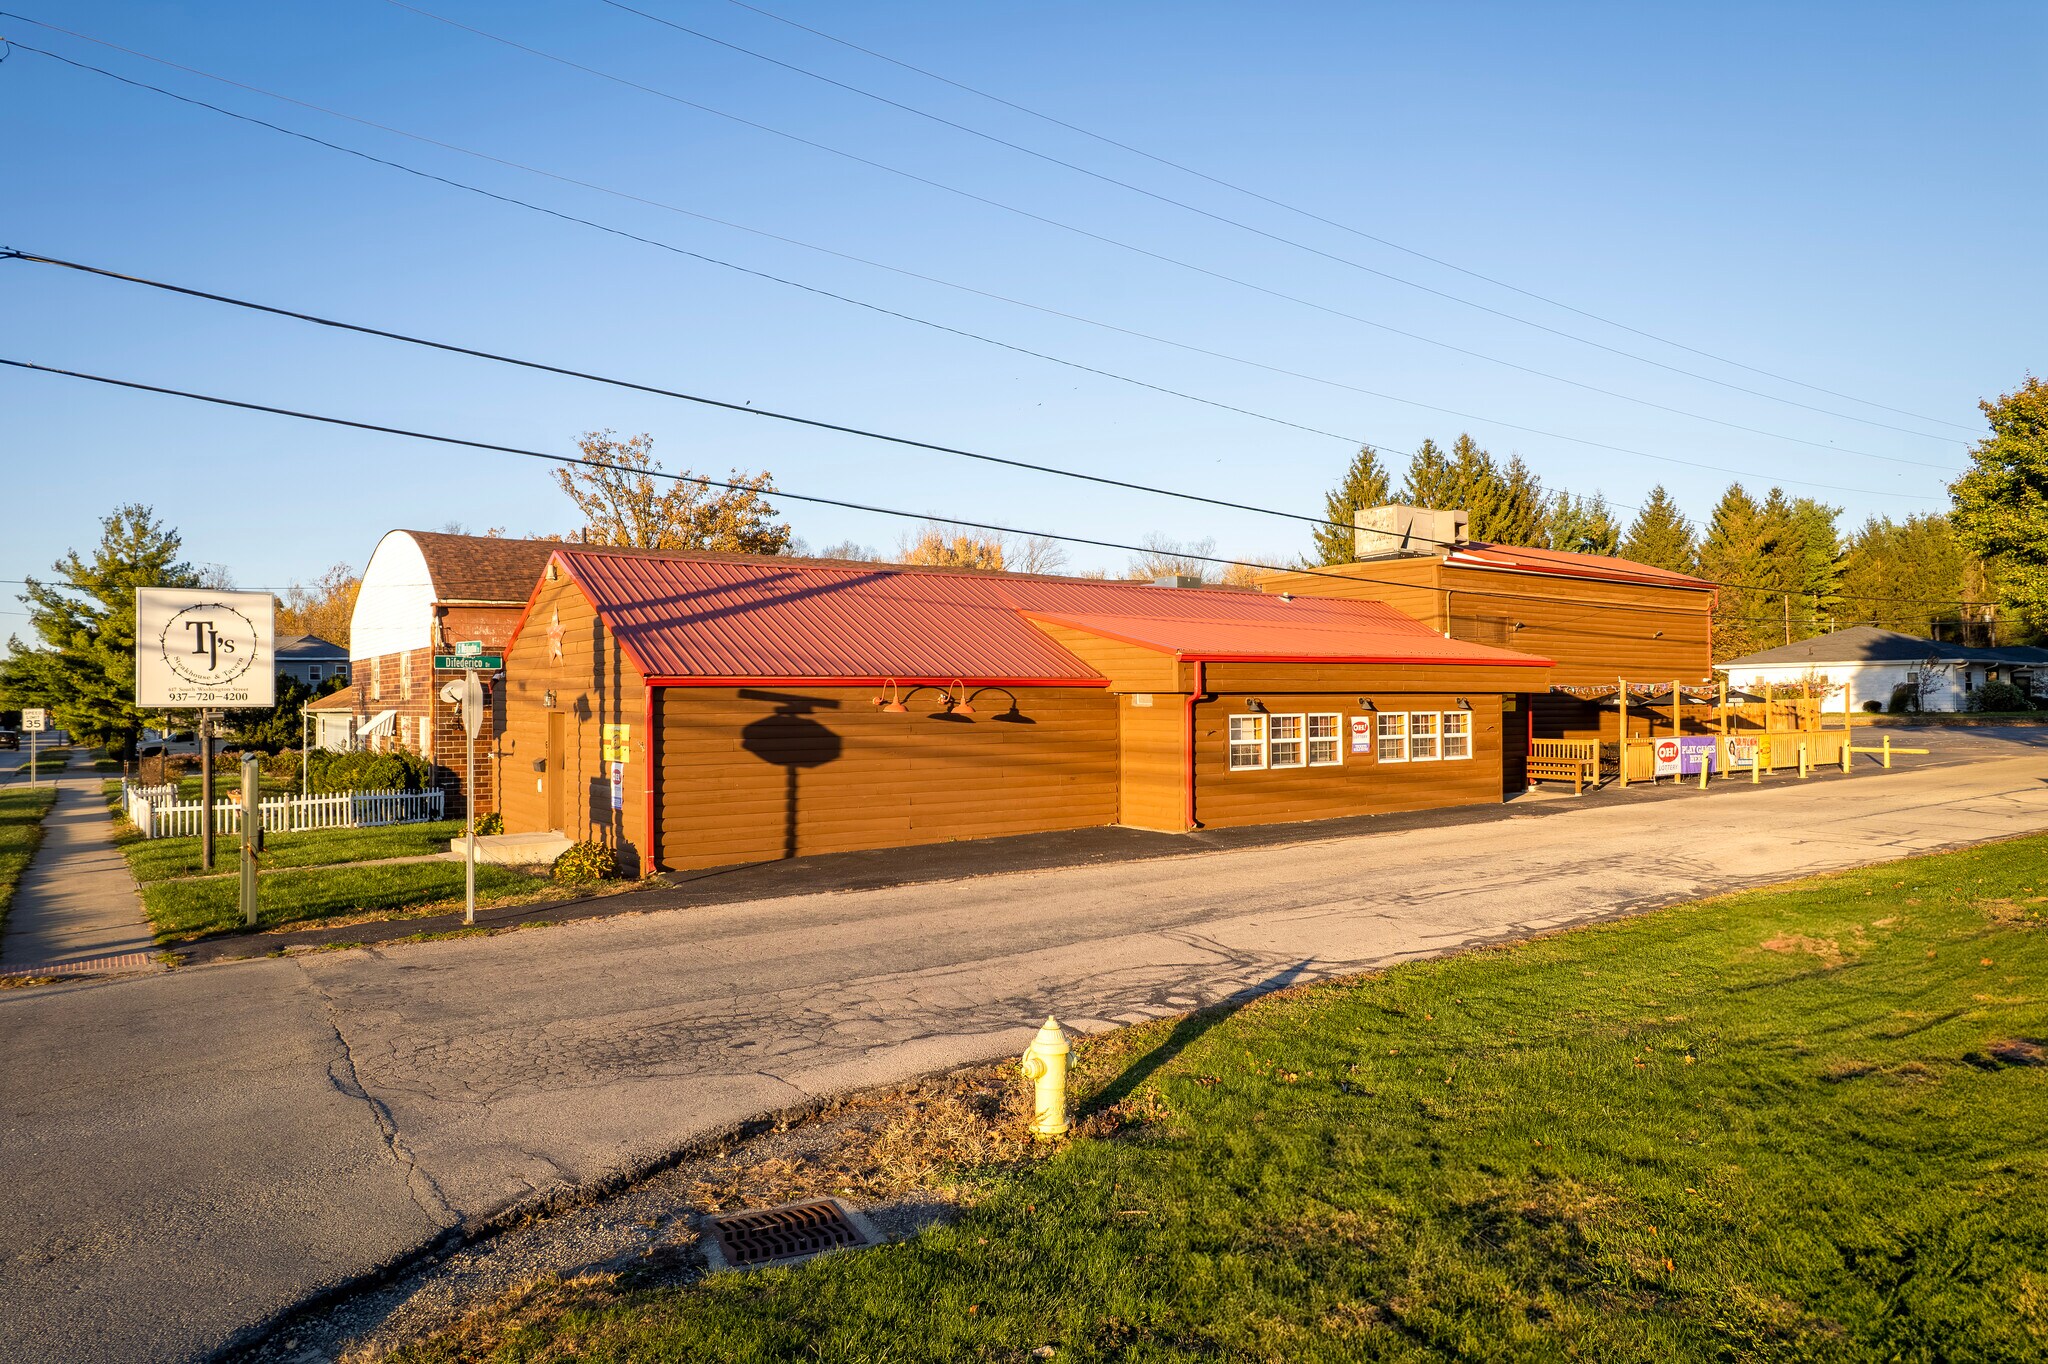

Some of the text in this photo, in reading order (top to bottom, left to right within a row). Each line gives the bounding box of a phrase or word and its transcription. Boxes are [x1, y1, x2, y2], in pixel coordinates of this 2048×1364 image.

[185, 621, 235, 671] TJ's
[174, 655, 211, 680] Steakhouse
[222, 657, 244, 676] Tavern
[445, 657, 483, 668] Difederico
[26, 720, 41, 728] 35
[1353, 723, 1367, 732] OH!
[1659, 745, 1678, 758] OH!
[1682, 745, 1696, 754] PLAY
[1659, 763, 1678, 771] LOTTERY
